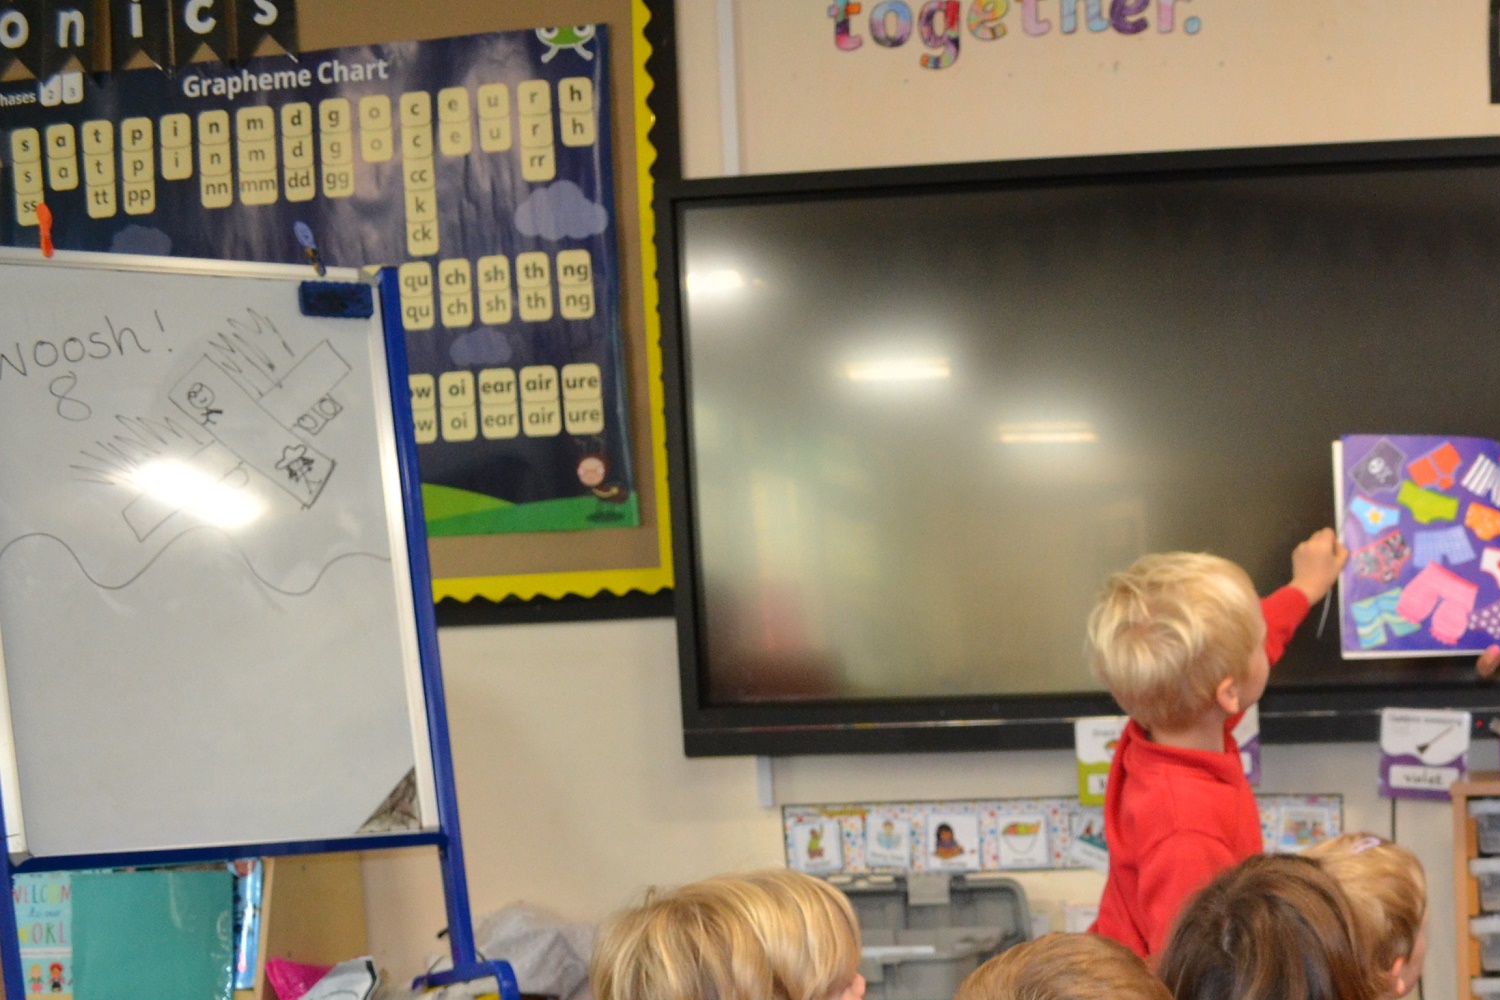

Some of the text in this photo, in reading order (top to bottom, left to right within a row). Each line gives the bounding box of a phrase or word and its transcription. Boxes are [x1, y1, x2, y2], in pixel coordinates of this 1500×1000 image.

[182, 58, 389, 100] Grapheme Chart
[21, 138, 30, 152] s
[55, 134, 67, 148] a
[93, 128, 102, 144] t
[131, 128, 143, 146] p
[208, 121, 220, 134] n
[246, 117, 264, 131] m
[290, 108, 302, 127] d
[327, 109, 339, 128] g
[368, 106, 381, 120] o
[410, 102, 420, 116] c
[486, 93, 499, 108] u
[529, 90, 538, 104] r
[569, 84, 582, 102] h
[24, 170, 32, 183] s
[58, 166, 69, 180] a
[95, 160, 103, 175] t
[132, 159, 144, 177] p
[210, 152, 221, 166] n
[248, 148, 266, 162] m
[292, 140, 303, 158] d
[329, 140, 341, 159] g
[370, 138, 382, 151] o
[412, 134, 421, 148] c
[489, 126, 500, 140] u
[531, 122, 540, 136] r
[571, 118, 585, 135] h
[23, 153, 545, 214] ss tt pp nn mm dd gg cc rr
[415, 196, 425, 214] k
[412, 225, 432, 243] ck
[403, 261, 589, 292] qu ch sh th ng
[405, 292, 591, 323] qu ch sh th ng
[448, 378, 466, 397] oi
[480, 379, 513, 394] ear
[525, 373, 553, 392] air
[565, 374, 599, 390] ure
[450, 411, 468, 431] oi
[484, 412, 516, 428] ear
[528, 406, 555, 425] air
[568, 407, 602, 424] ure
